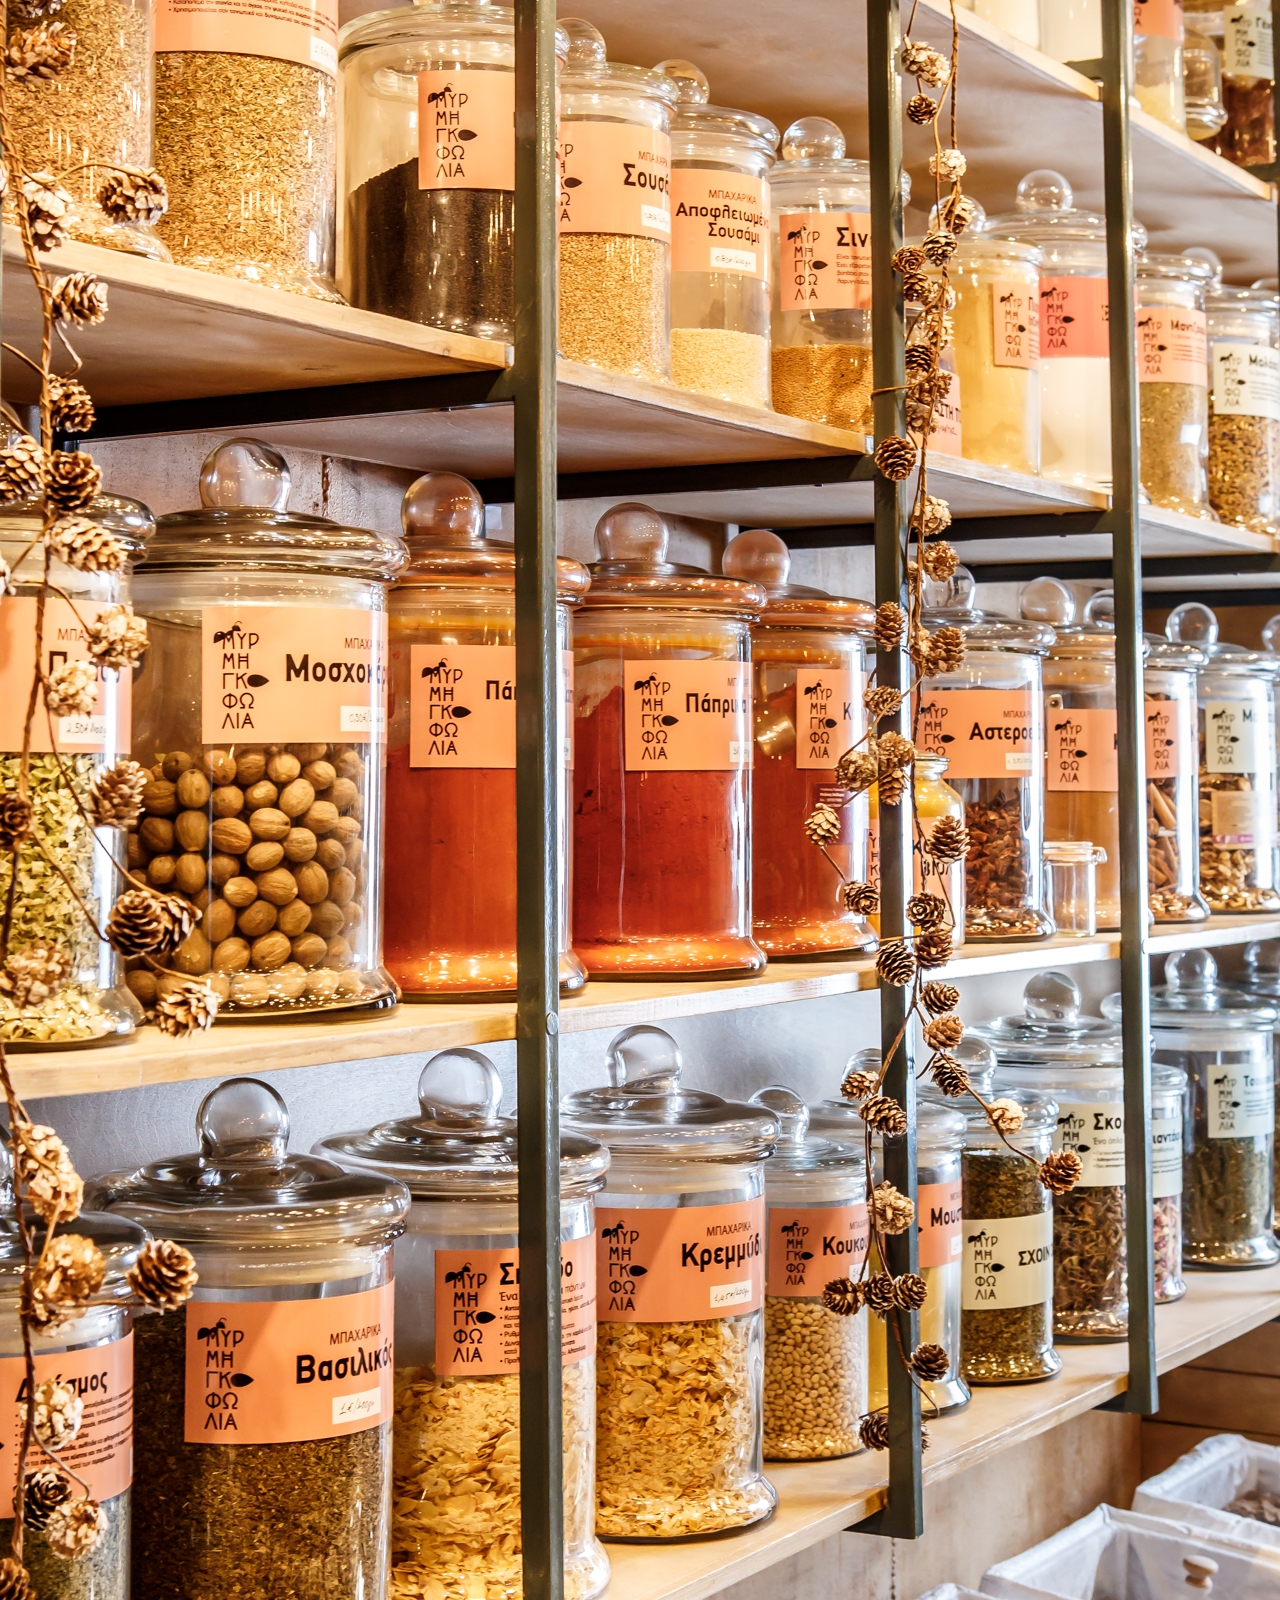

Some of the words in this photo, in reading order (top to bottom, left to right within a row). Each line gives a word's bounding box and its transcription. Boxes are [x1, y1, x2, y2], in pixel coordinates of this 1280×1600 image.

[436, 111, 459, 126] ΜΗ
[436, 145, 465, 160] ΦΩ
[436, 163, 465, 178] ΛΙΑ
[708, 189, 758, 206] ΜΠΑΧΑΡΙΚΑ
[708, 222, 760, 246] Σουσάμι
[836, 226, 869, 247] Σιν
[222, 653, 249, 669] ΜΗ
[429, 687, 453, 701] ΜΗ
[486, 680, 516, 700] Πά
[222, 693, 254, 709] ΦΩ
[641, 698, 663, 711] ΜΗ
[810, 703, 827, 715] ΜΗ
[221, 713, 254, 729] ΛΙΑ
[924, 721, 942, 732] ΜΗ
[429, 723, 458, 737] ΦΩ
[642, 730, 668, 743] ΦΩ
[969, 722, 1034, 745] Αστεροε
[809, 732, 830, 744] ΦΩ
[1060, 737, 1076, 747] ΜΗ
[428, 741, 458, 755] ΛΙΑ
[641, 746, 668, 760] ΛΙΑ
[809, 746, 830, 759] ΛΙΑ
[1060, 761, 1079, 771] ΦΩ
[1060, 773, 1080, 783] ΛΙΑ
[1093, 1113, 1122, 1130] Σκο
[1063, 1131, 1079, 1141] ΜΗ
[706, 1221, 752, 1237] ΜΠΑΧΑΡΙΚΑ
[786, 1239, 803, 1249] ΜΗ
[609, 1247, 631, 1261] ΜΗ
[974, 1250, 992, 1261] ΜΗ
[786, 1263, 806, 1273] ΦΩ
[785, 1274, 805, 1285] ΛΙΑ
[975, 1276, 996, 1287] ΦΩ
[609, 1280, 635, 1294] ΦΩ
[453, 1292, 478, 1307] ΜΗ
[499, 1292, 518, 1302] Ένα
[975, 1289, 997, 1300] ΛΙΑ
[609, 1297, 635, 1311] ΛΙΑ
[330, 1323, 381, 1346] ΜΠΑΧΑΡΙΚΑ
[453, 1329, 483, 1344] ΦΩ
[206, 1351, 233, 1368] ΜΗ
[296, 1337, 392, 1384] Βασιλικός
[453, 1347, 483, 1363] ΛΙΑ
[205, 1392, 238, 1409] ΦΩ
[204, 1413, 238, 1430] ΛΙΑ
